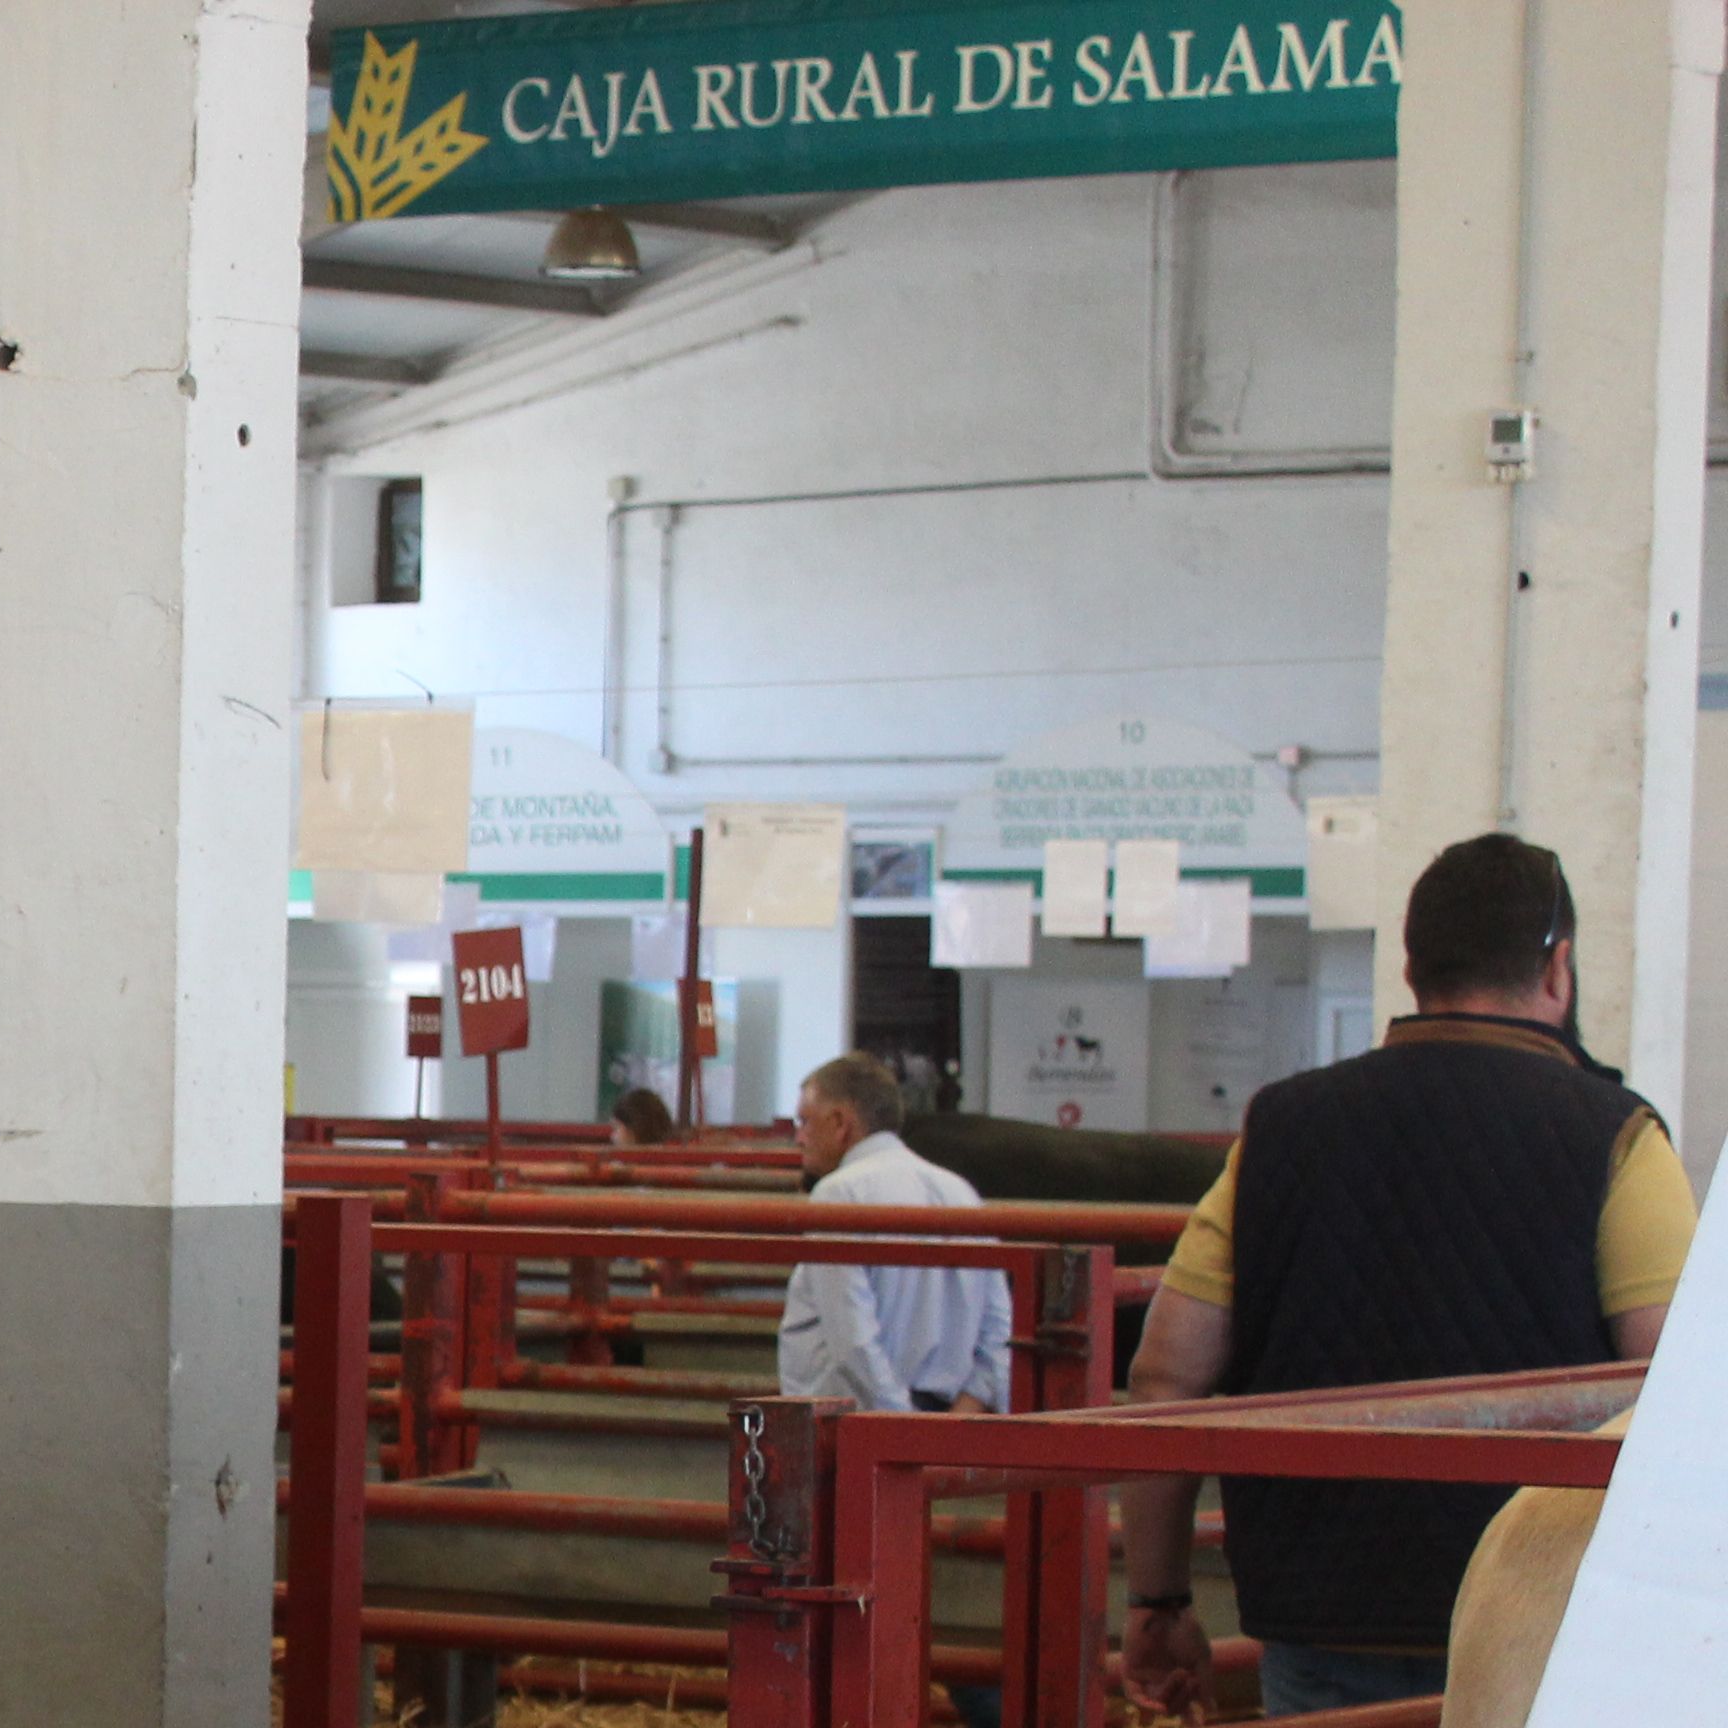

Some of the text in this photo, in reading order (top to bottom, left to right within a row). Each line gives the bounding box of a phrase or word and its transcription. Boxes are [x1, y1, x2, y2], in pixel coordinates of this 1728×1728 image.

[501, 67, 674, 158] CAJA
[691, 50, 935, 130] RURAL
[954, 39, 1053, 113] DE
[1120, 720, 1146, 744] 10
[491, 746, 513, 768] 11
[460, 962, 523, 1004] 2104
